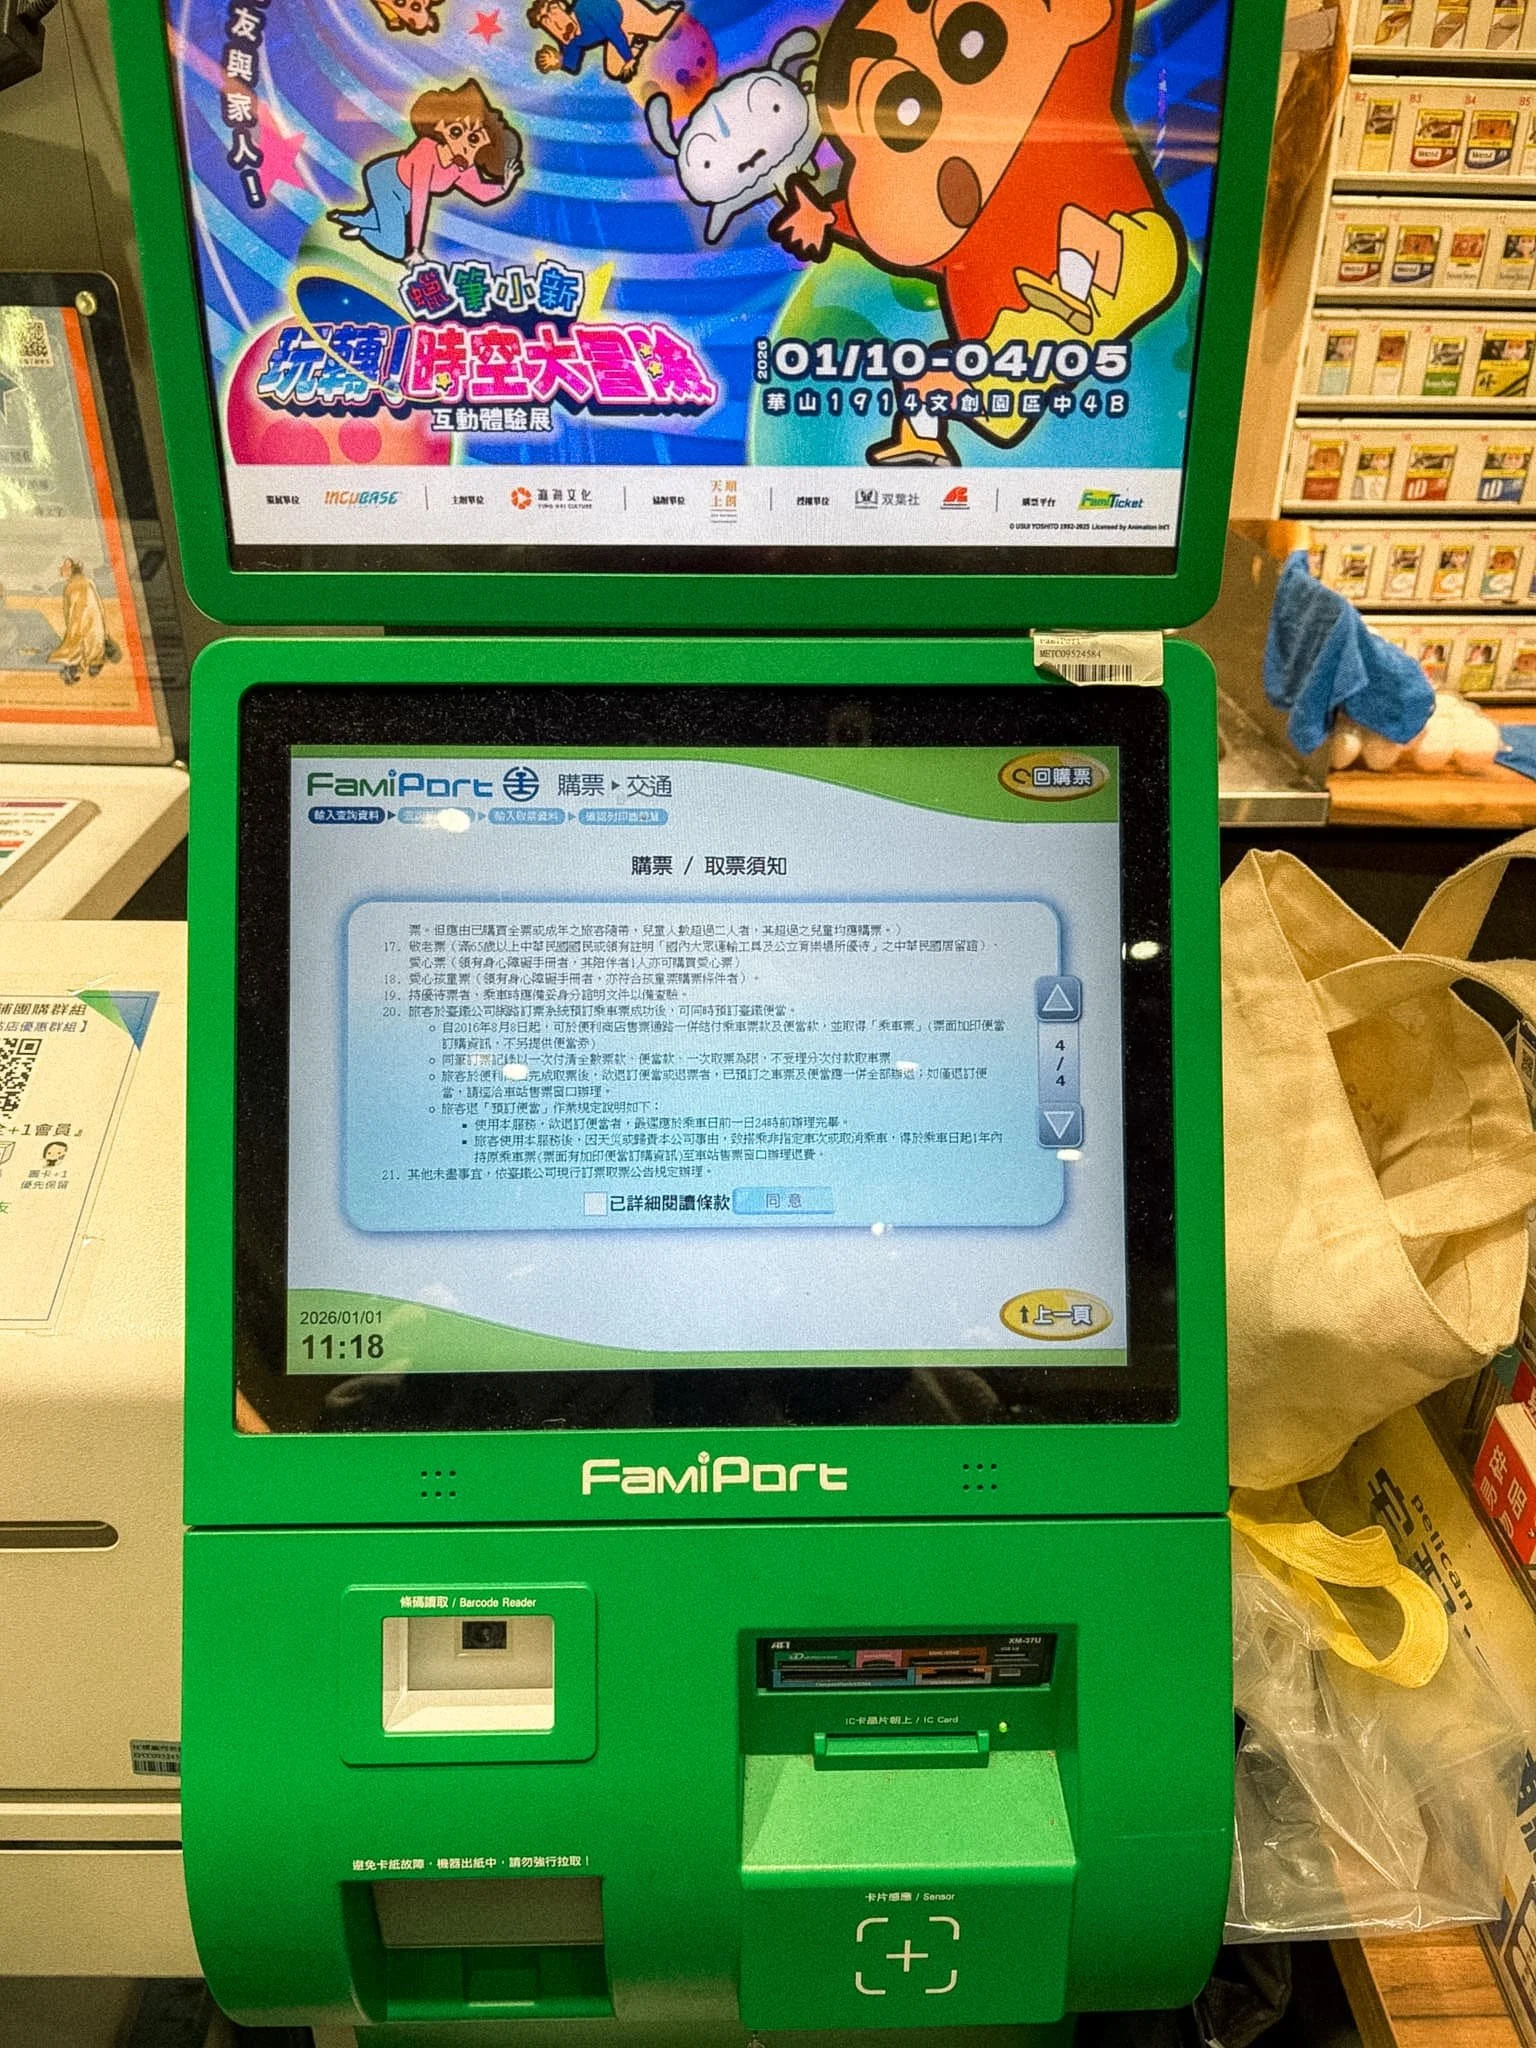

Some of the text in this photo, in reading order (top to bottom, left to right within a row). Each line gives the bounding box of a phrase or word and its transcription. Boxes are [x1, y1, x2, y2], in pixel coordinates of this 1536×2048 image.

[402, 262, 585, 317] 蠟筆小新
[757, 340, 768, 380] 2026
[774, 344, 1128, 377] 01/10-04/05
[432, 408, 553, 431] 互動體驗展
[323, 491, 399, 505] INCUBASE
[307, 768, 493, 797] FamiPort
[557, 774, 673, 798] 購票 交通
[1033, 766, 1092, 787] 回購票
[632, 855, 788, 876] 購票 / 取票須知
[384, 942, 401, 952] 17.
[384, 973, 401, 985] 18.
[384, 989, 401, 1001] 19.
[382, 1006, 401, 1017] 20.
[382, 1168, 401, 1180] 21.
[609, 1193, 731, 1212] 已詳細閱讀條款
[300, 1311, 382, 1325] 2026/01/01
[1033, 1304, 1093, 1326] 上一頁
[302, 1334, 384, 1359] 11:18
[582, 1451, 848, 1495] FamiPort
[459, 1597, 499, 1608] Barcode
[502, 1597, 537, 1608] Reader
[924, 1716, 934, 1724] IC
[937, 1715, 959, 1724] Card
[923, 1892, 956, 1901] Sensor
